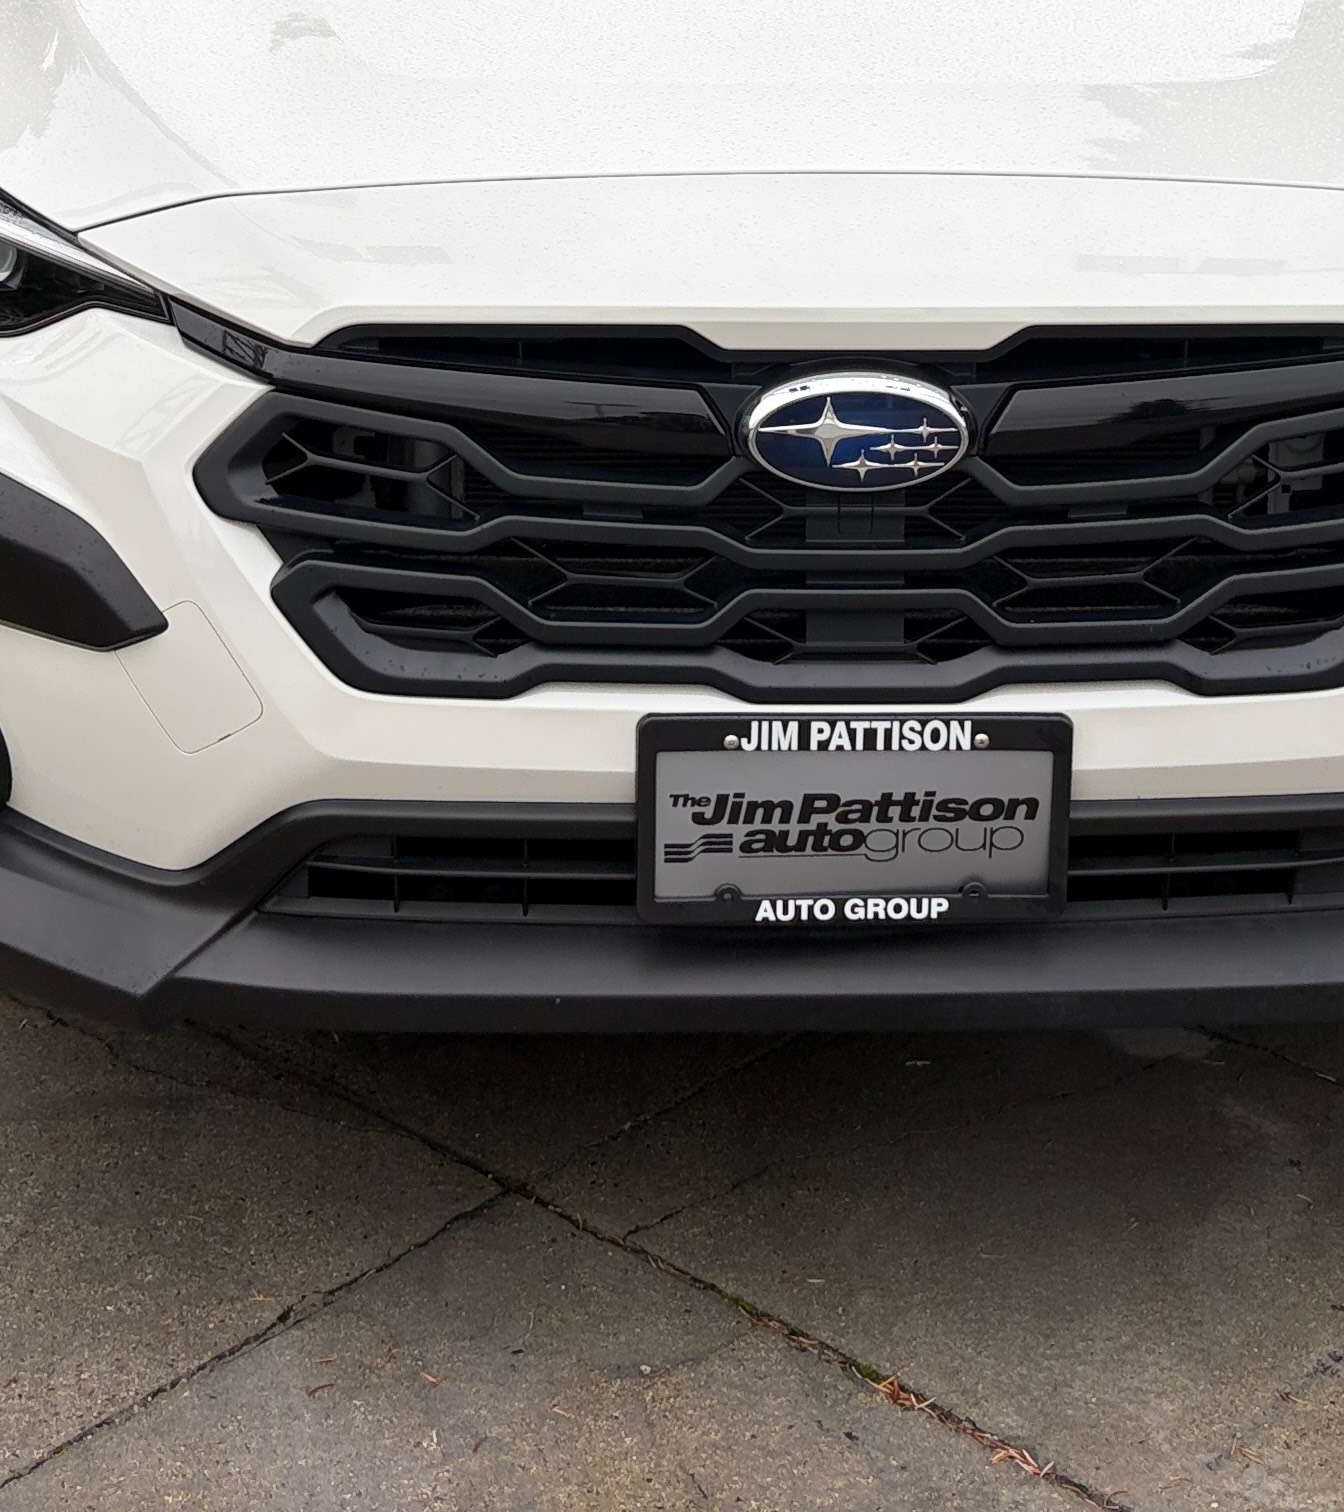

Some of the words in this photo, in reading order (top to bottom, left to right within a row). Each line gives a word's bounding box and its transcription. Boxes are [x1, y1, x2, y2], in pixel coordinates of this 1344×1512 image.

[740, 720, 799, 751] JIM
[809, 719, 973, 752] PATTISON
[669, 793, 712, 809] The
[691, 792, 795, 826] Jim
[796, 790, 1040, 826] Pattison
[755, 899, 836, 922] AUTO
[843, 897, 950, 921] GROUP
